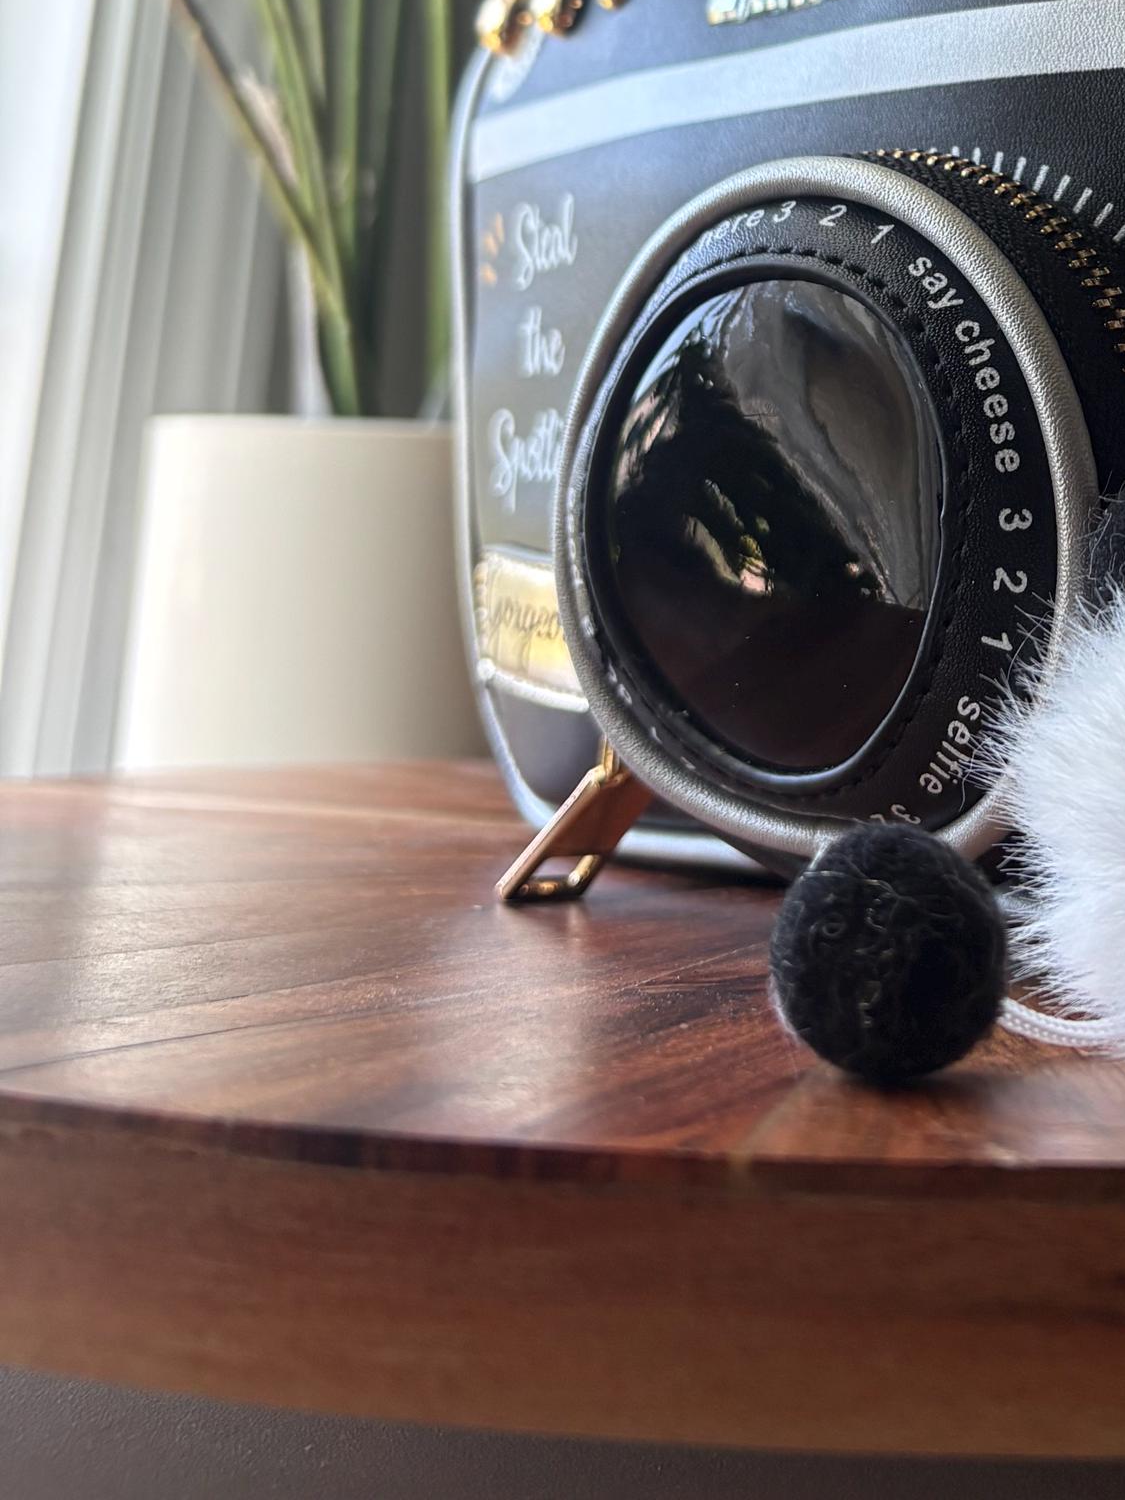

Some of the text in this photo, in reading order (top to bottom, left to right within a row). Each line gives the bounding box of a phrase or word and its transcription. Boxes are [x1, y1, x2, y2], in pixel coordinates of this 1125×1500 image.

[772, 200, 797, 223] 3
[818, 204, 848, 227] 2
[869, 223, 895, 245] 1
[908, 256, 965, 309] say
[954, 319, 1020, 473] cheese
[998, 507, 1033, 532] 3
[993, 567, 1028, 594] 2
[980, 632, 1013, 651] 1
[920, 695, 981, 794] selfie
